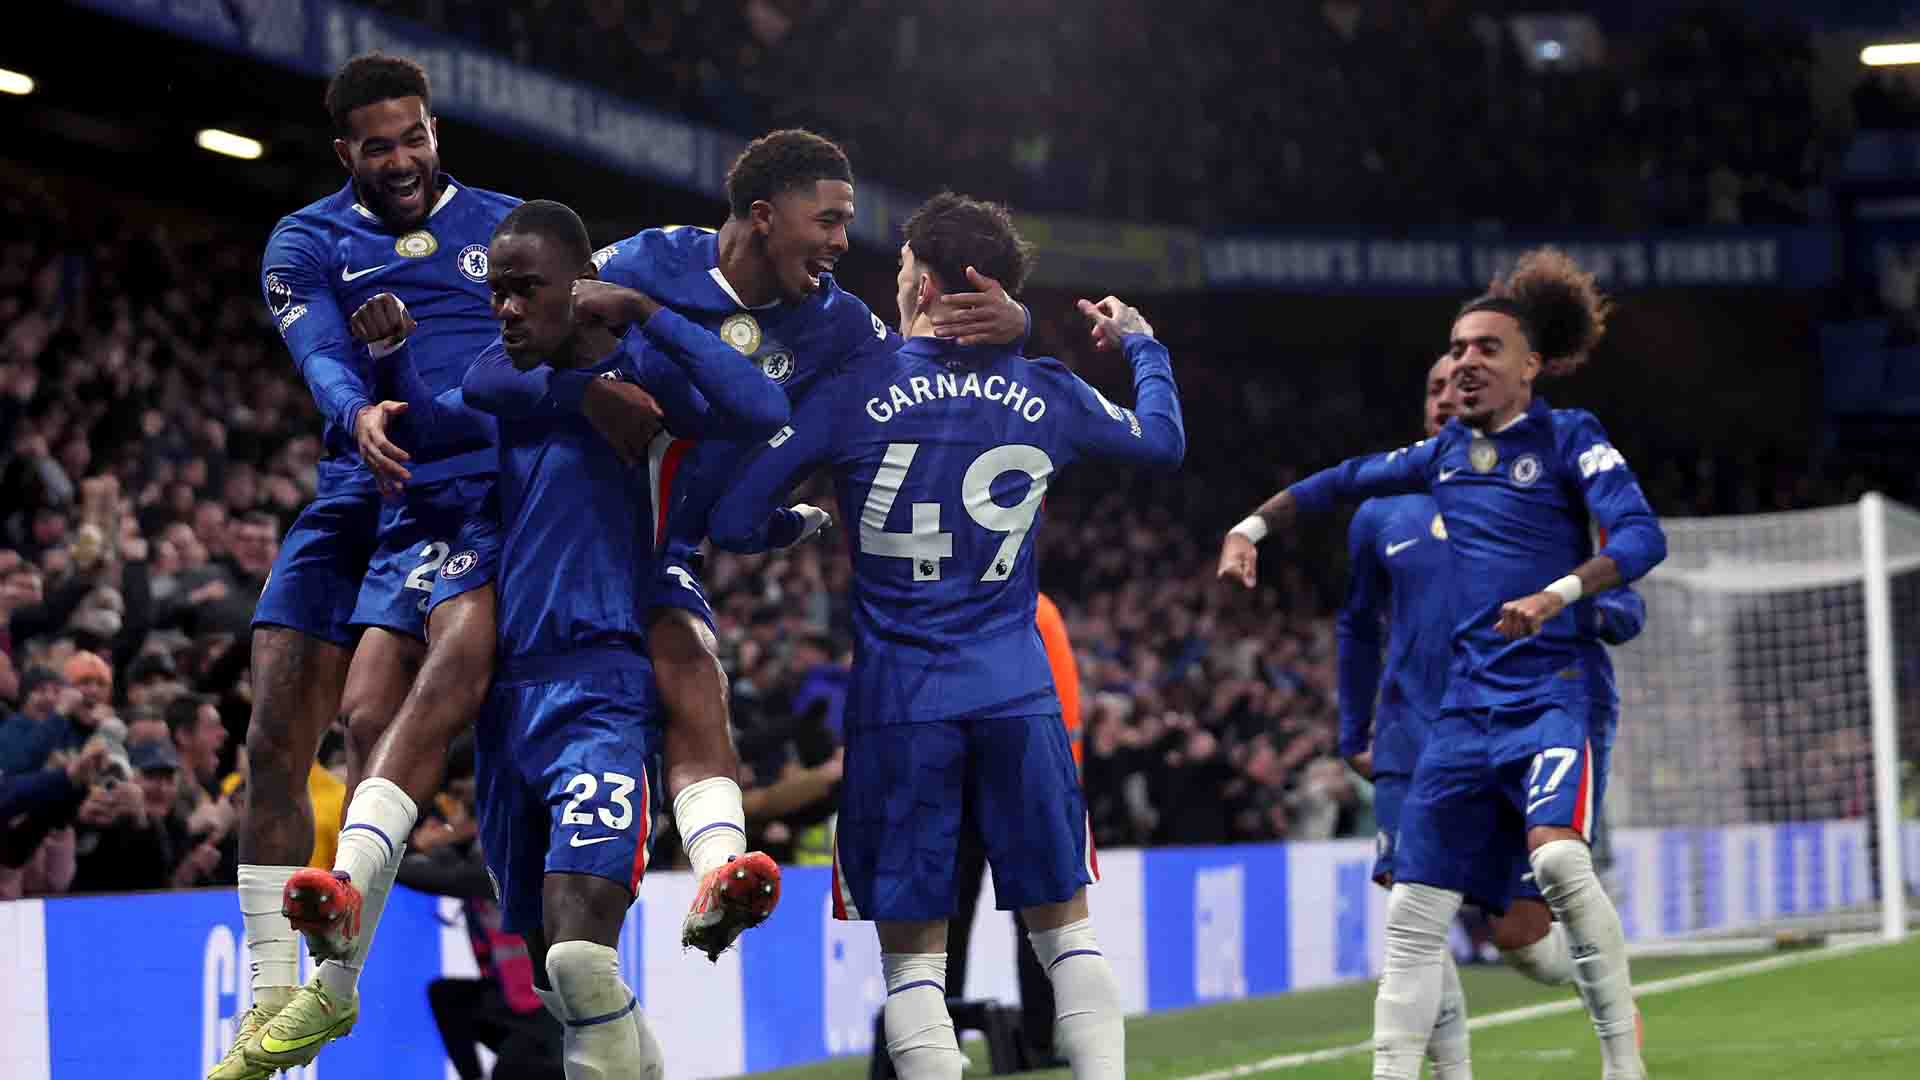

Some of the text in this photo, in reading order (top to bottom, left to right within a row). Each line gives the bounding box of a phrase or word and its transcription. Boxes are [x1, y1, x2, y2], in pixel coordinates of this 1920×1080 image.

[865, 372, 1047, 423] GARNACHO
[859, 443, 1055, 583] 49
[561, 772, 636, 830] 23
